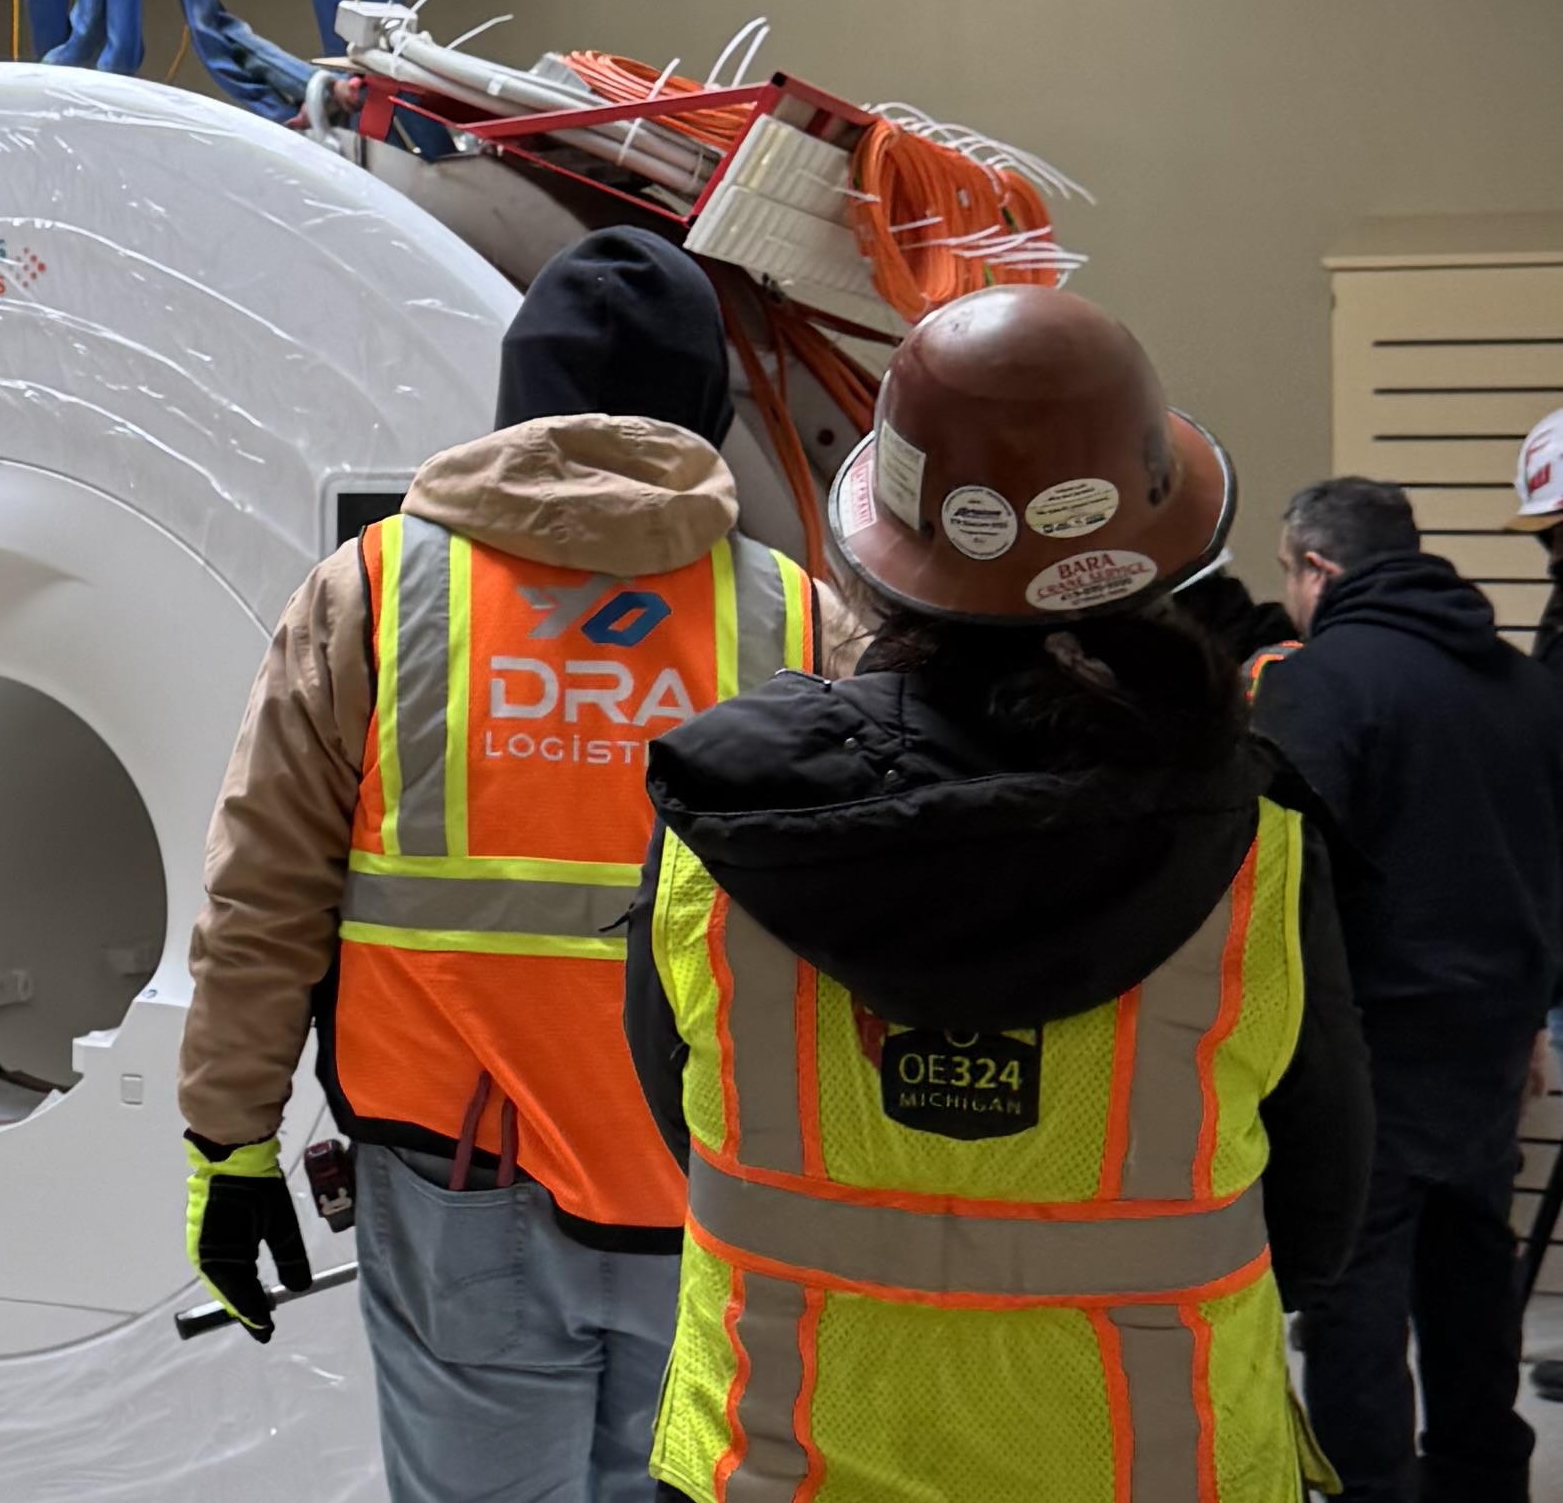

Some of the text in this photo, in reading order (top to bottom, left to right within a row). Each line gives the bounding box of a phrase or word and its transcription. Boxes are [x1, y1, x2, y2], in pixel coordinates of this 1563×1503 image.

[1058, 553, 1115, 579] BARA
[490, 656, 697, 726] DRA
[485, 730, 649, 767] LOGISTI
[899, 1053, 1022, 1090] OE324
[900, 1092, 1022, 1115] MICHIGAN
